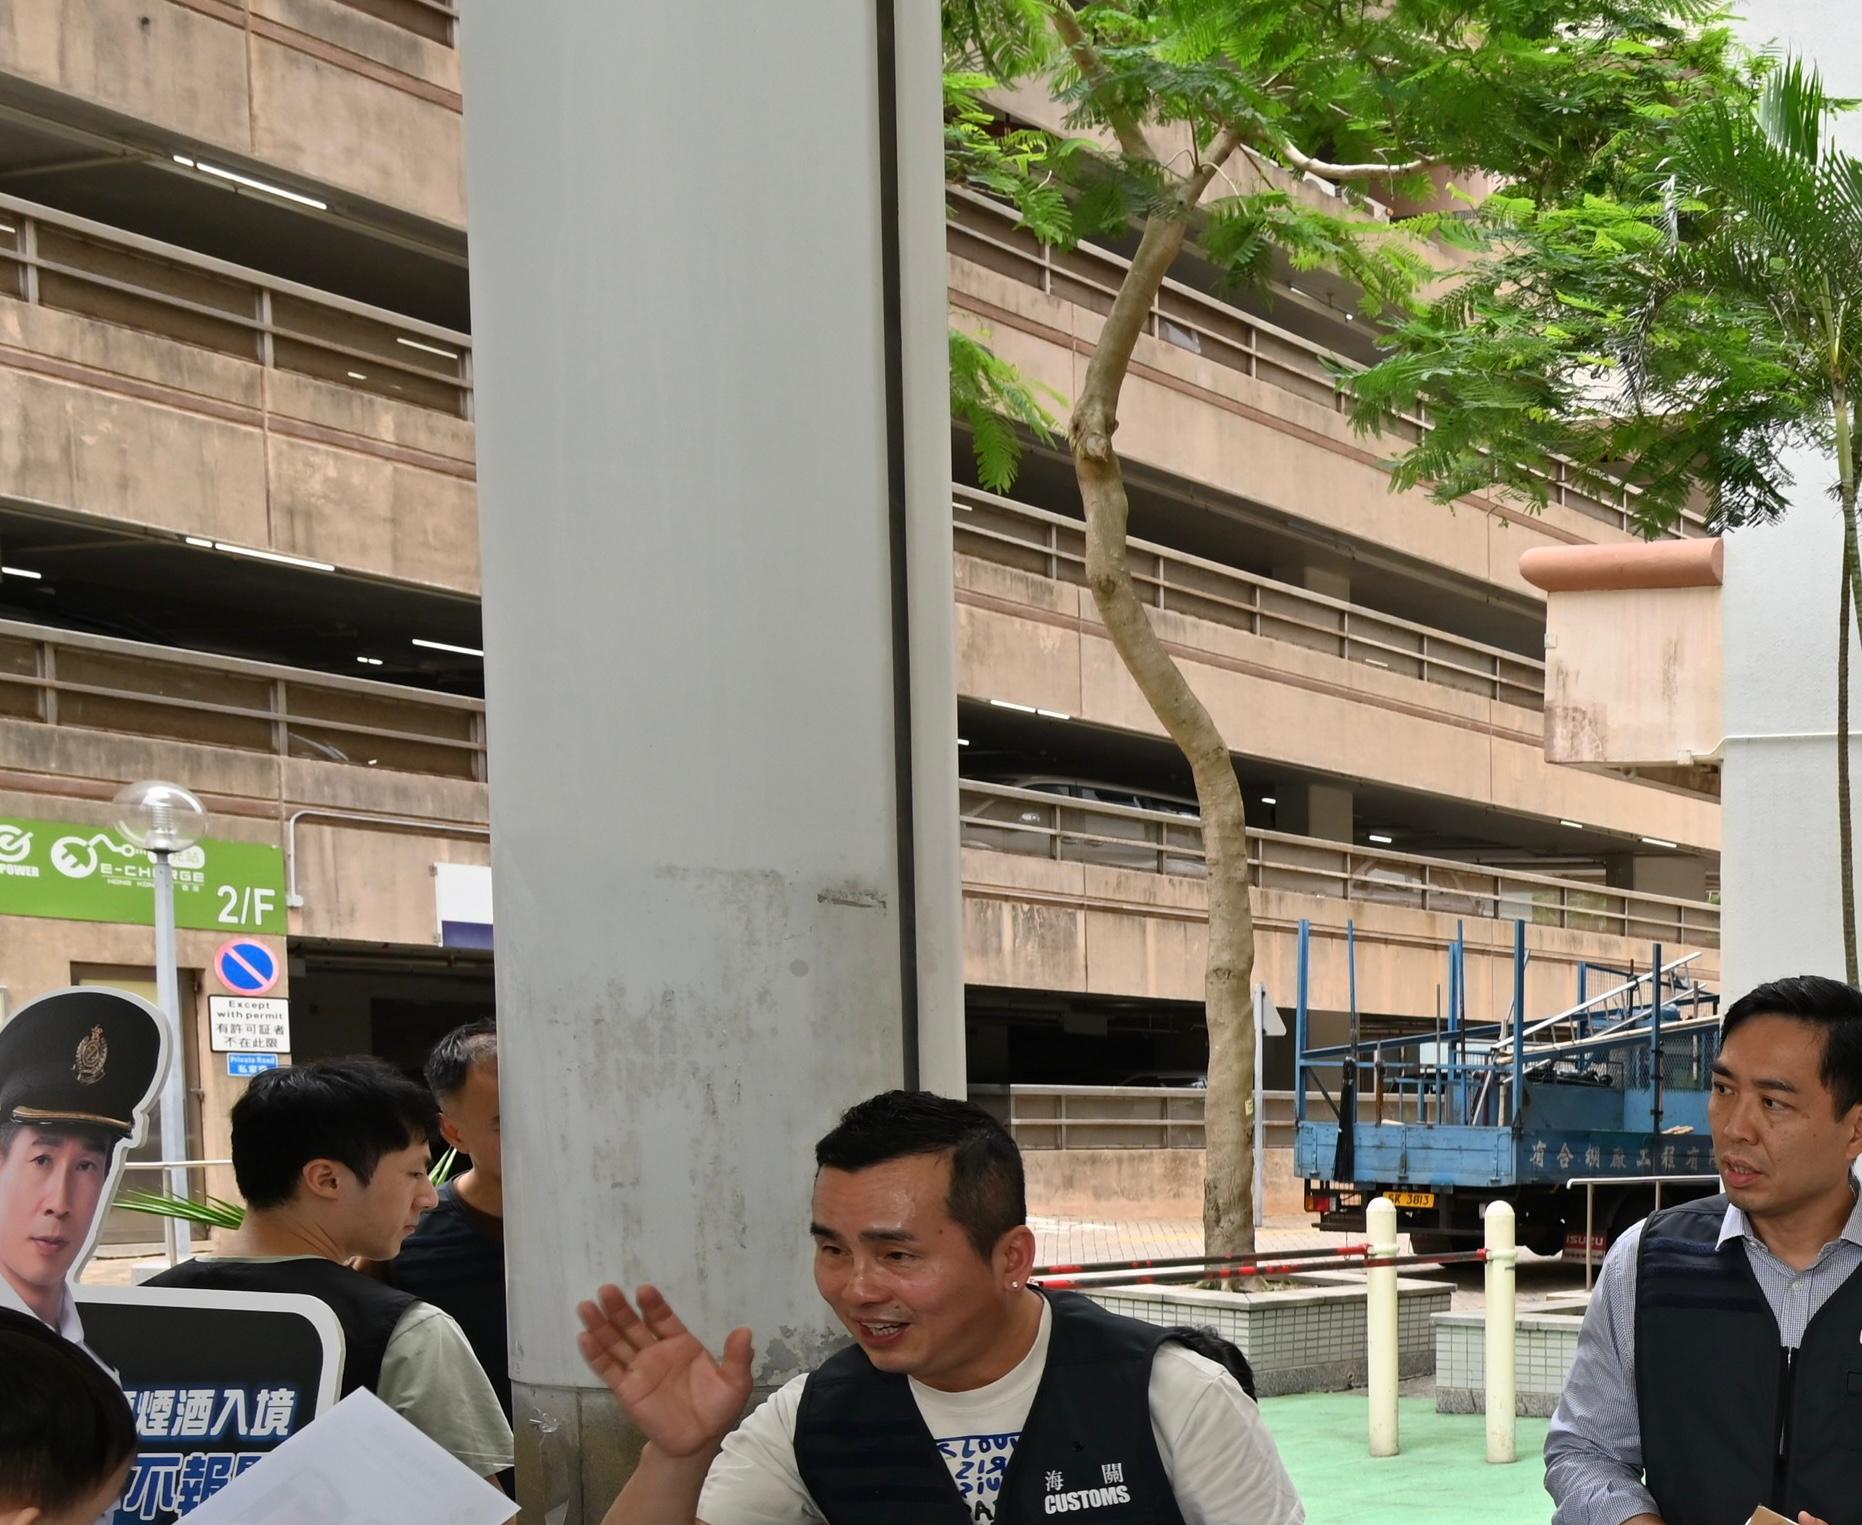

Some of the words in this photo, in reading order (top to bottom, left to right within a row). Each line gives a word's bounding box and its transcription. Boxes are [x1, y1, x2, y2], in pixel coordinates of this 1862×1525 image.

[100, 863, 204, 882] E-CHRGE
[217, 885, 276, 925] 2/F
[229, 1000, 270, 1010] Except
[224, 1038, 278, 1047] 不在此限
[1045, 1470, 1064, 1492] 海
[1102, 1462, 1124, 1484] 關
[1044, 1485, 1131, 1515] CUSTOMS
